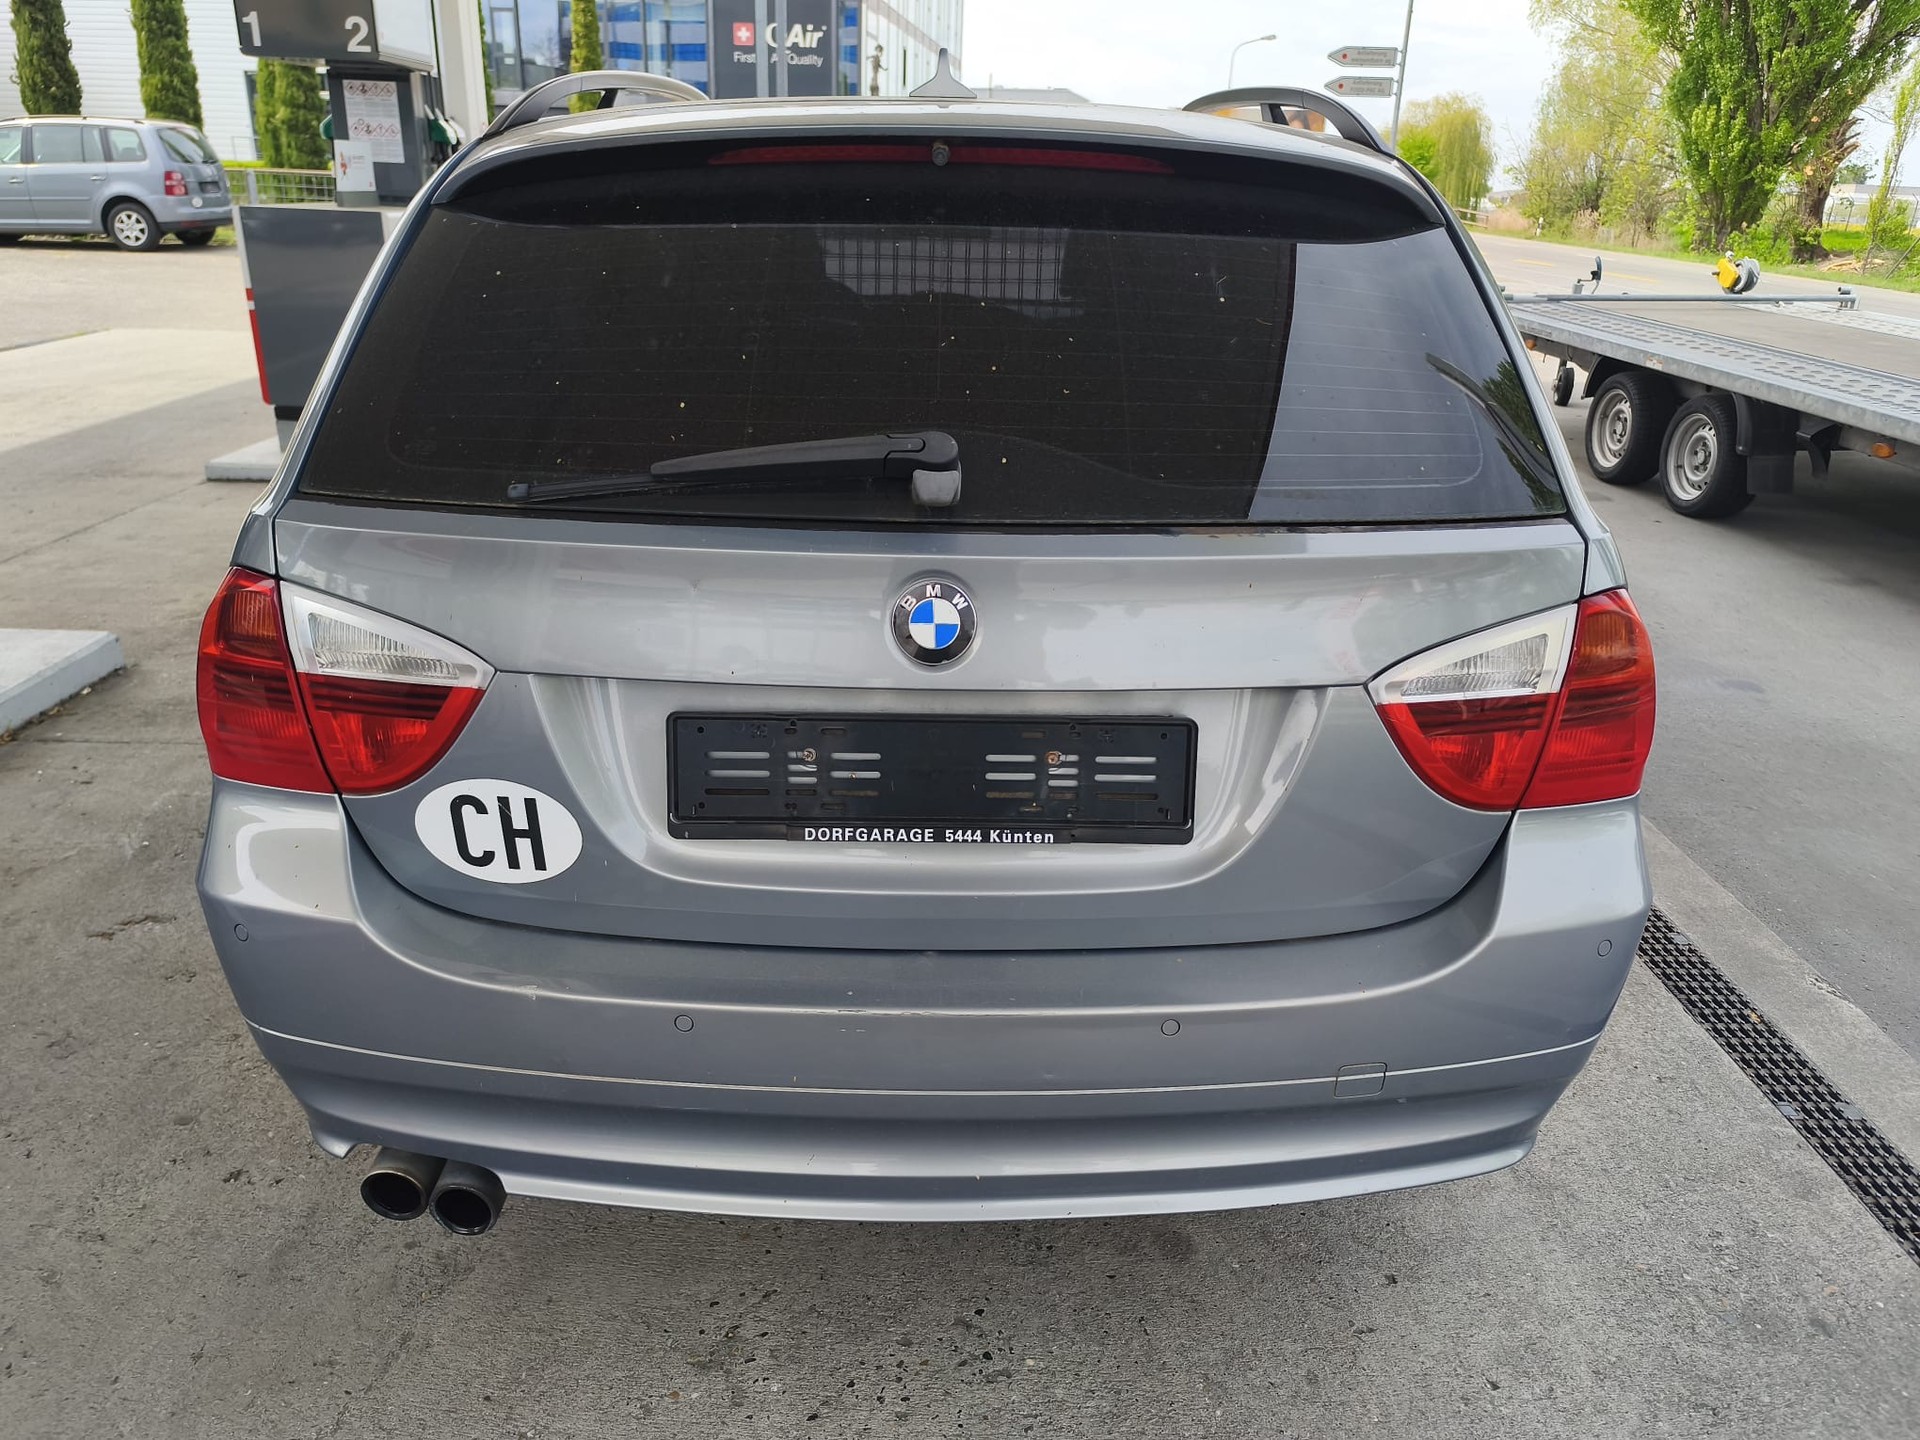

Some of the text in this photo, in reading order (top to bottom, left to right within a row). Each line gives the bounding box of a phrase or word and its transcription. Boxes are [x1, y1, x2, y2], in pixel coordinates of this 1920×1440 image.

[242, 11, 262, 46] 1
[344, 16, 372, 52] 2
[900, 584, 968, 611] BMW
[450, 794, 547, 871] CH
[804, 827, 1054, 844] DORFGARAGE 5444 Künten
